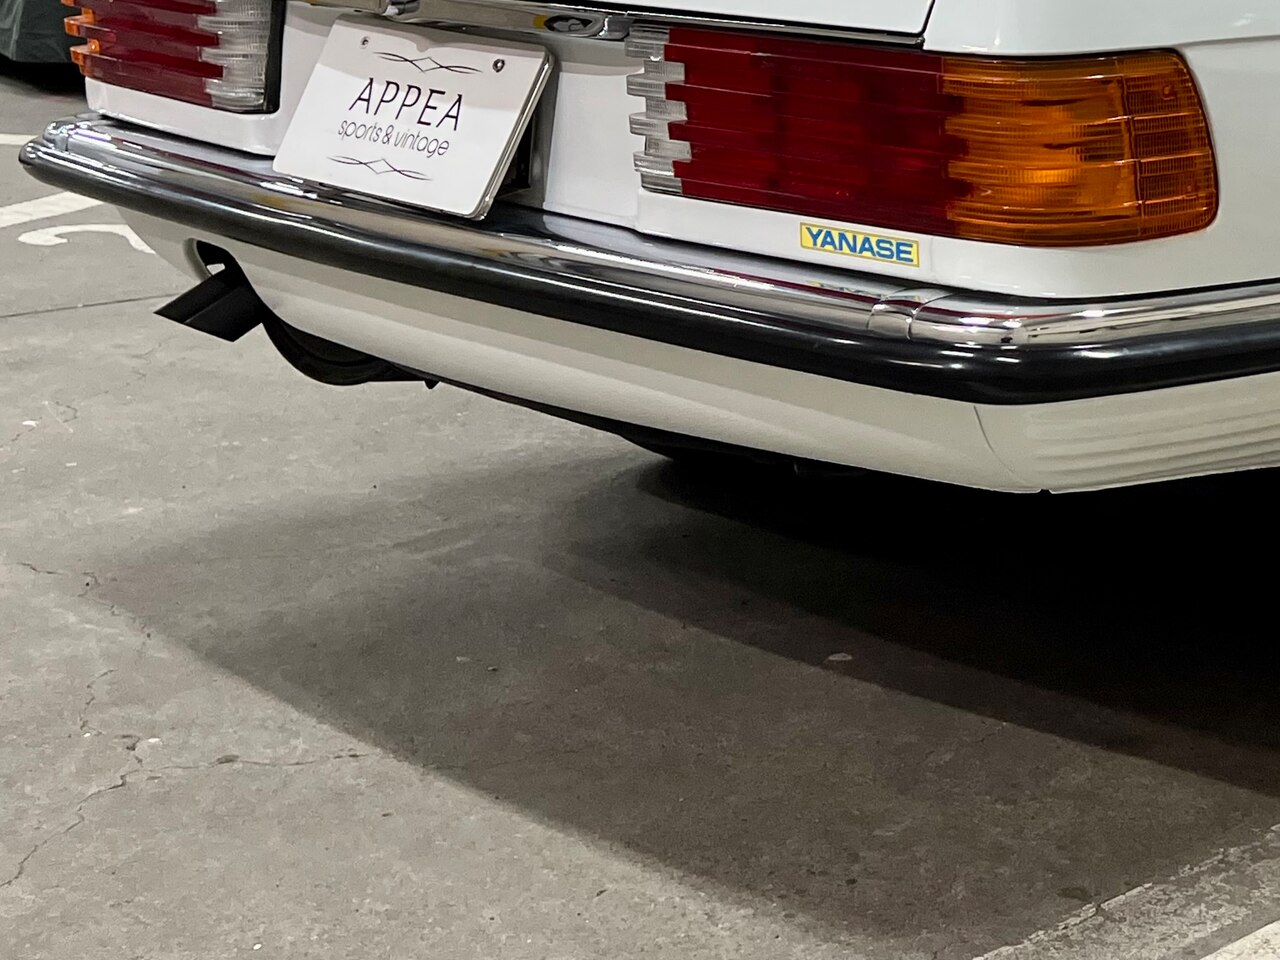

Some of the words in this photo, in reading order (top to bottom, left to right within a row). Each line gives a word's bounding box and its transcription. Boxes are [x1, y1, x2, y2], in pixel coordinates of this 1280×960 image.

[348, 76, 463, 132] APPEA
[337, 119, 381, 144] sports
[394, 127, 450, 158] vintage
[805, 226, 914, 263] YANASE
